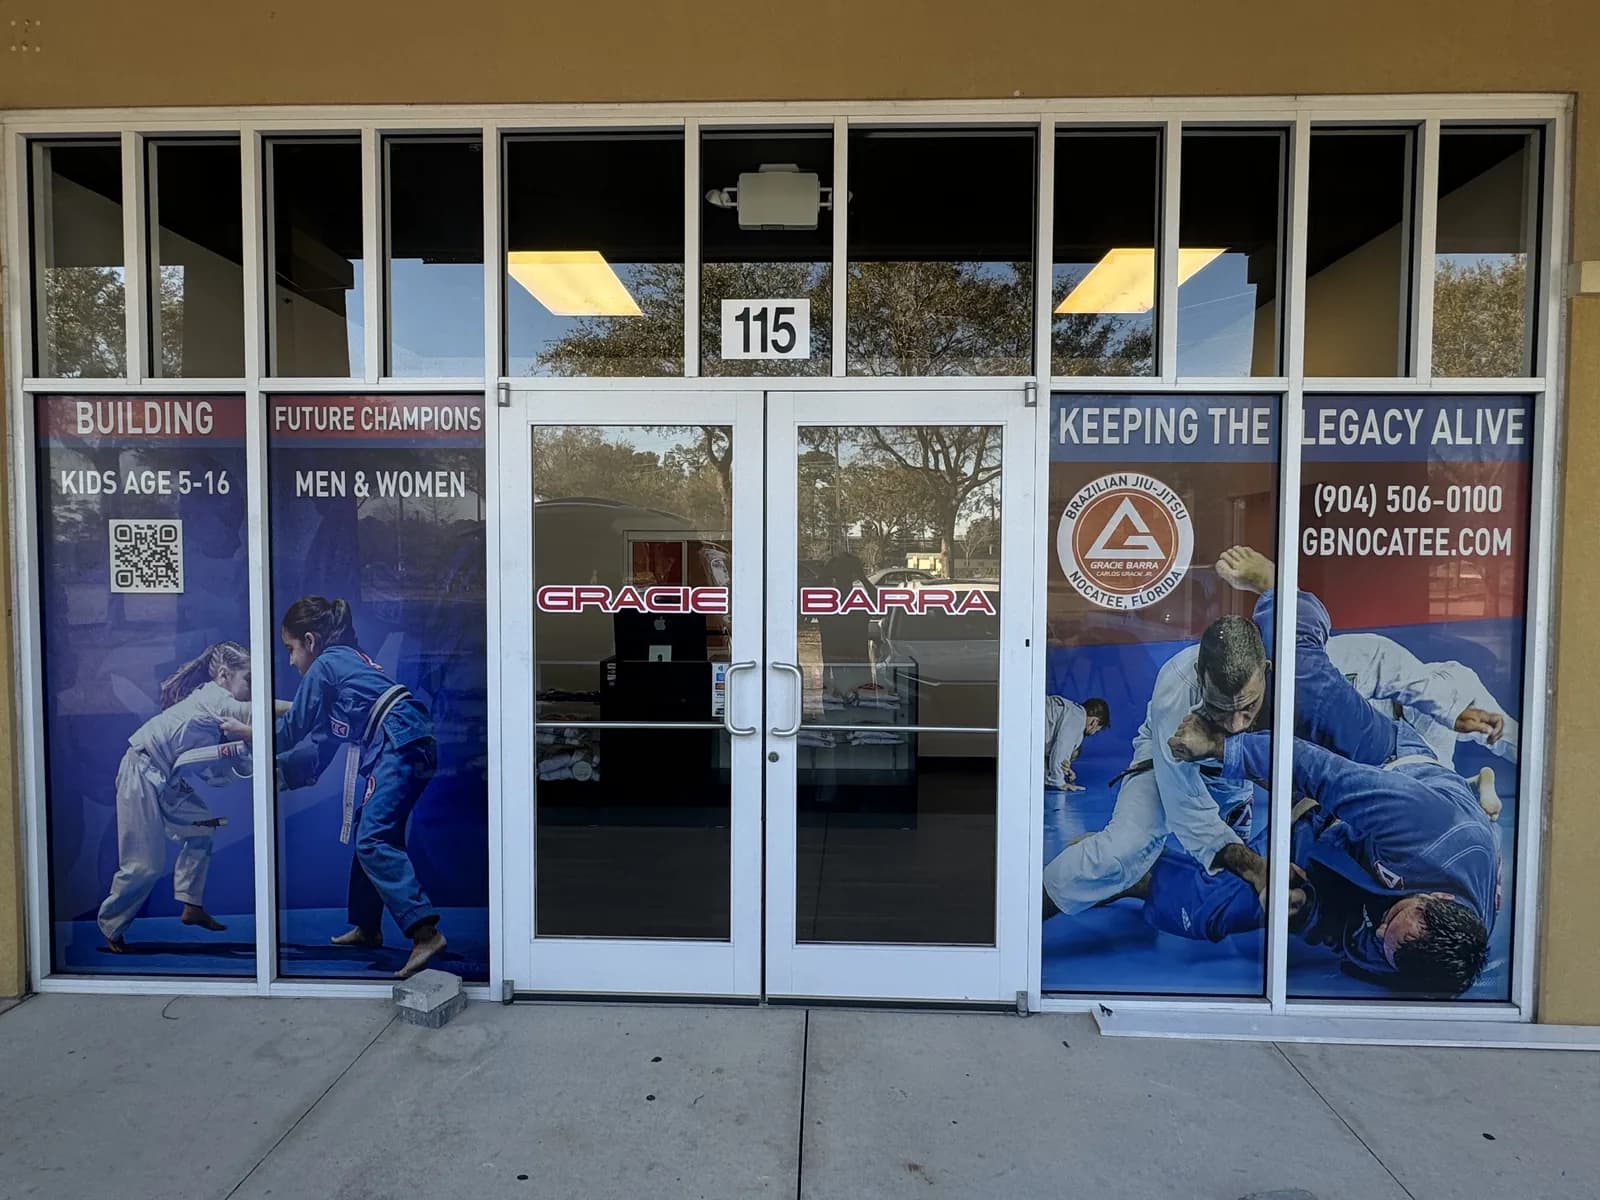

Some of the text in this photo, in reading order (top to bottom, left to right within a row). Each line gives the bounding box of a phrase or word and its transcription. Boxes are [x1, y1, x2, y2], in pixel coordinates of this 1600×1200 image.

[735, 307, 796, 353] 115
[76, 402, 214, 435] BUILDING
[275, 406, 481, 431] FUTURE CHAMPIONS
[1059, 407, 1526, 446] KEEPING THE LEGACY ALIVE
[61, 470, 230, 495] KIDS AGE 5-16
[296, 471, 466, 498] MEN & WOMEN
[1065, 475, 1187, 520] BRAZILIAN JIU-JITSU
[1313, 483, 1503, 517] (904) 506-0100
[1302, 527, 1512, 557] GBNOCATEE.COM
[1090, 561, 1159, 570] GRACIE BARRA
[537, 585, 997, 616] GRACIE BARRA
[1069, 570, 1182, 609] NOCATEE, FLORIDA
